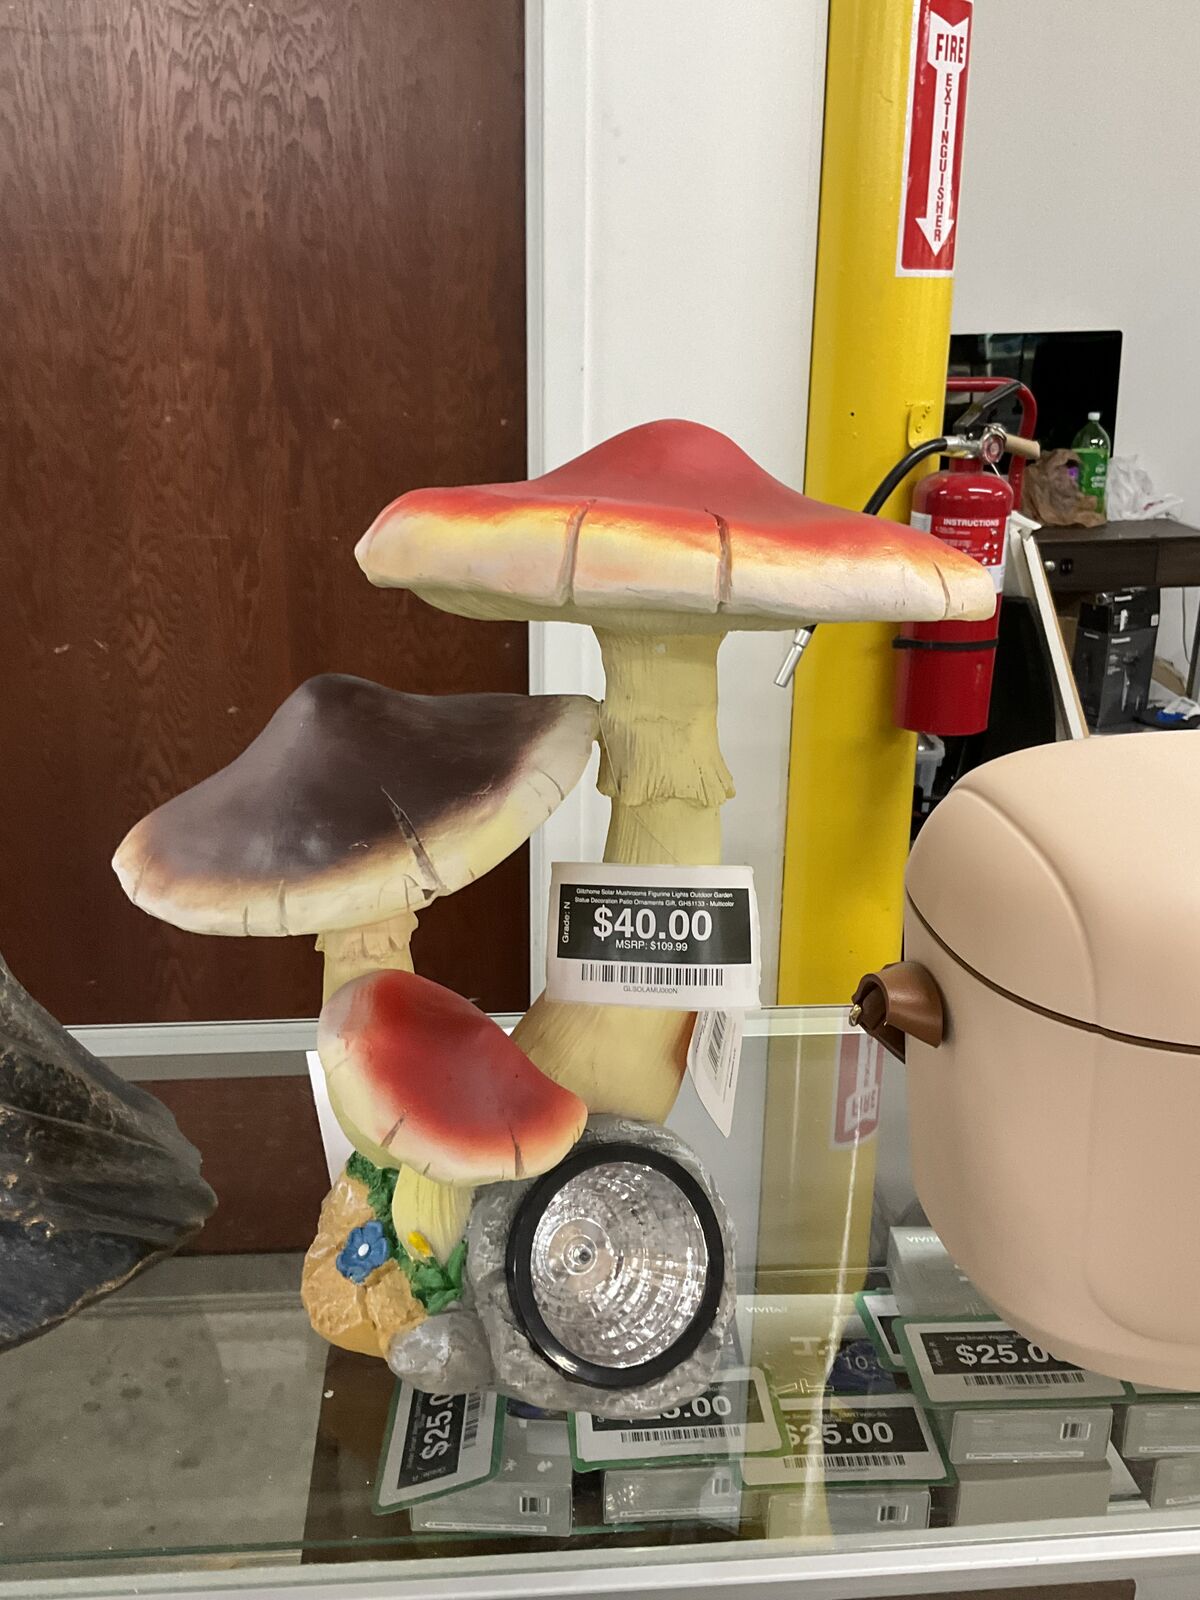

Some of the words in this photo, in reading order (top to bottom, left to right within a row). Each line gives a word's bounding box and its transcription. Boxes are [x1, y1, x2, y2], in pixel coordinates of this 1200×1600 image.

[935, 33, 964, 64] FIRE
[933, 73, 953, 242] EXTINGUISHER
[943, 517, 999, 527] INSTRUCTIONS
[563, 901, 571, 909] N
[634, 898, 665, 906] Ornaments
[648, 890, 671, 898] Figurine
[562, 911, 571, 944] Grade:
[593, 905, 713, 941] $40.00
[615, 940, 648, 950] MSRP:
[650, 941, 688, 952] $109.99
[955, 1344, 1049, 1367] $25.0
[420, 1394, 453, 1460] $25.0
